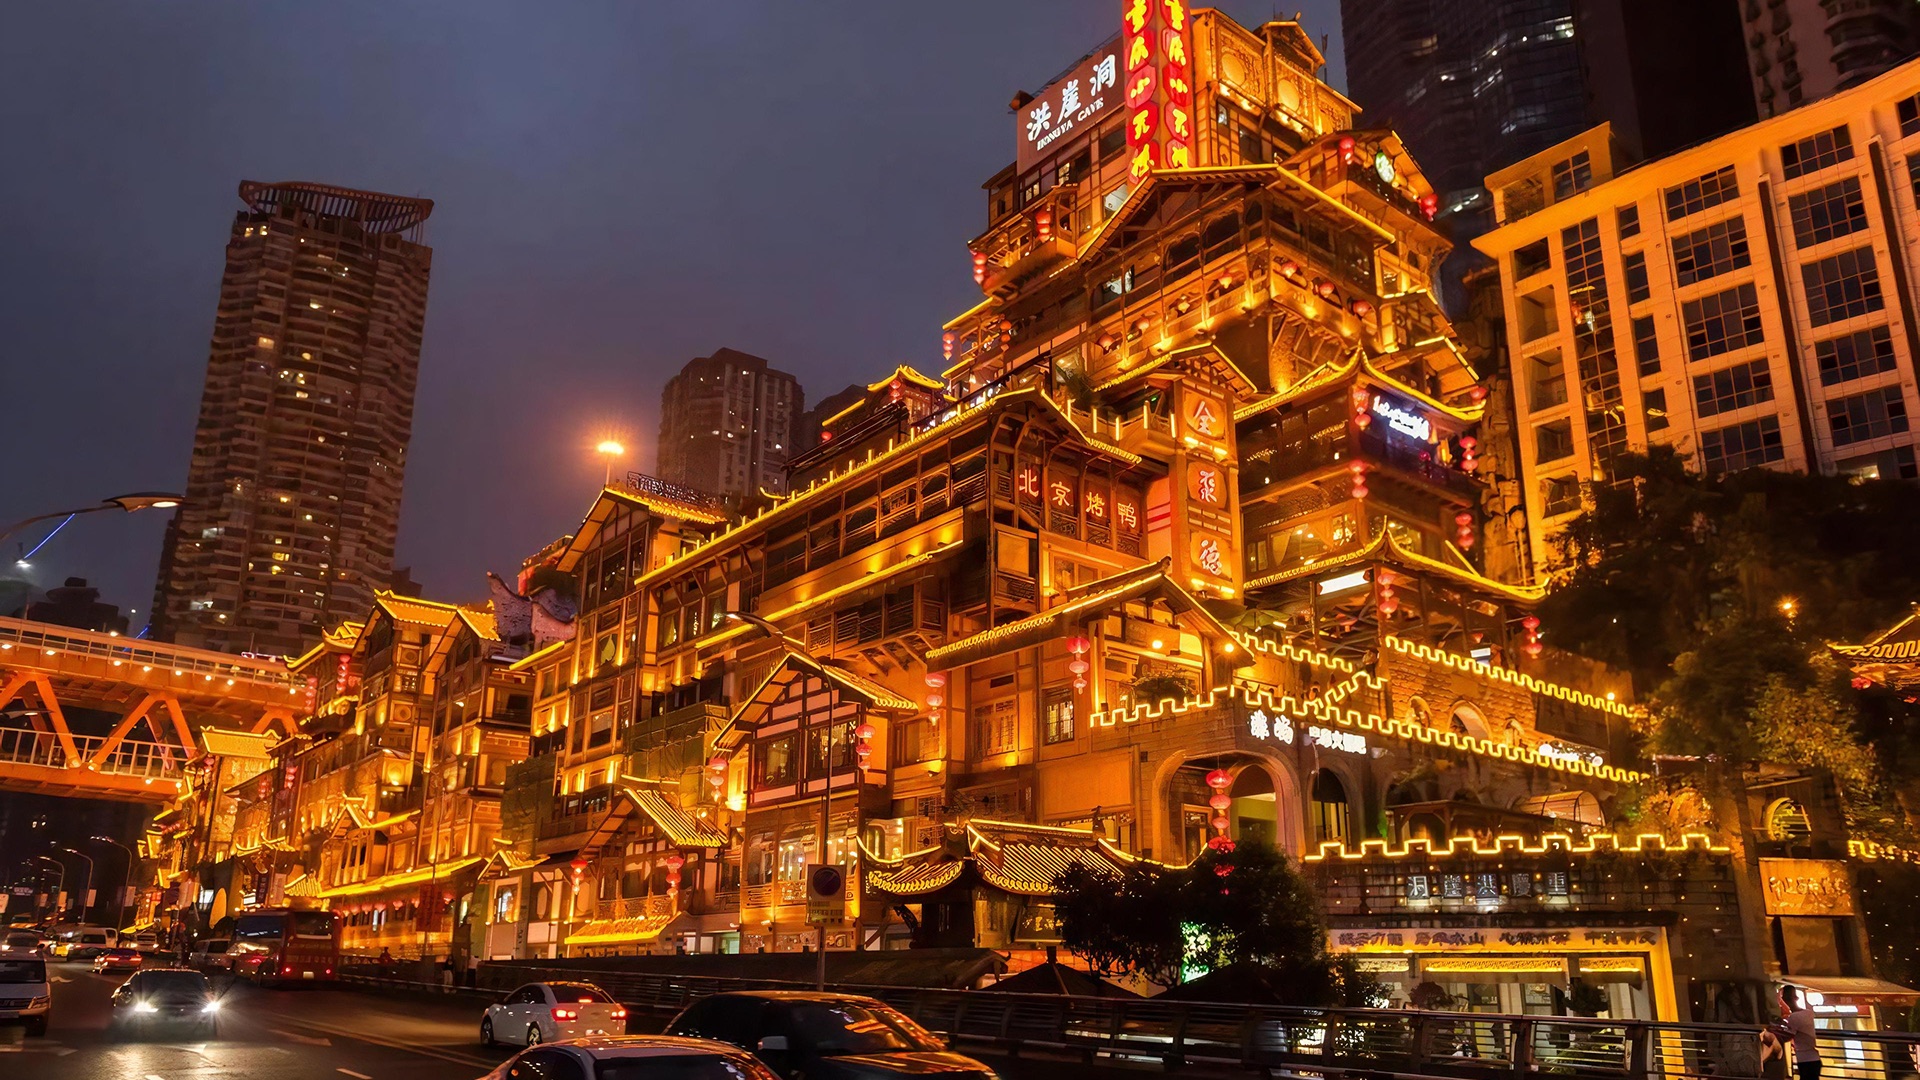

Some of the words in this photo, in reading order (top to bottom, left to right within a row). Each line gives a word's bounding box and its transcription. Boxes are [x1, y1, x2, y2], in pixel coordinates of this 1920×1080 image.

[1026, 54, 1116, 141] 洪崖洞
[1019, 469, 1137, 528] 北京烤鸭
[1194, 401, 1222, 576] 全聚德
